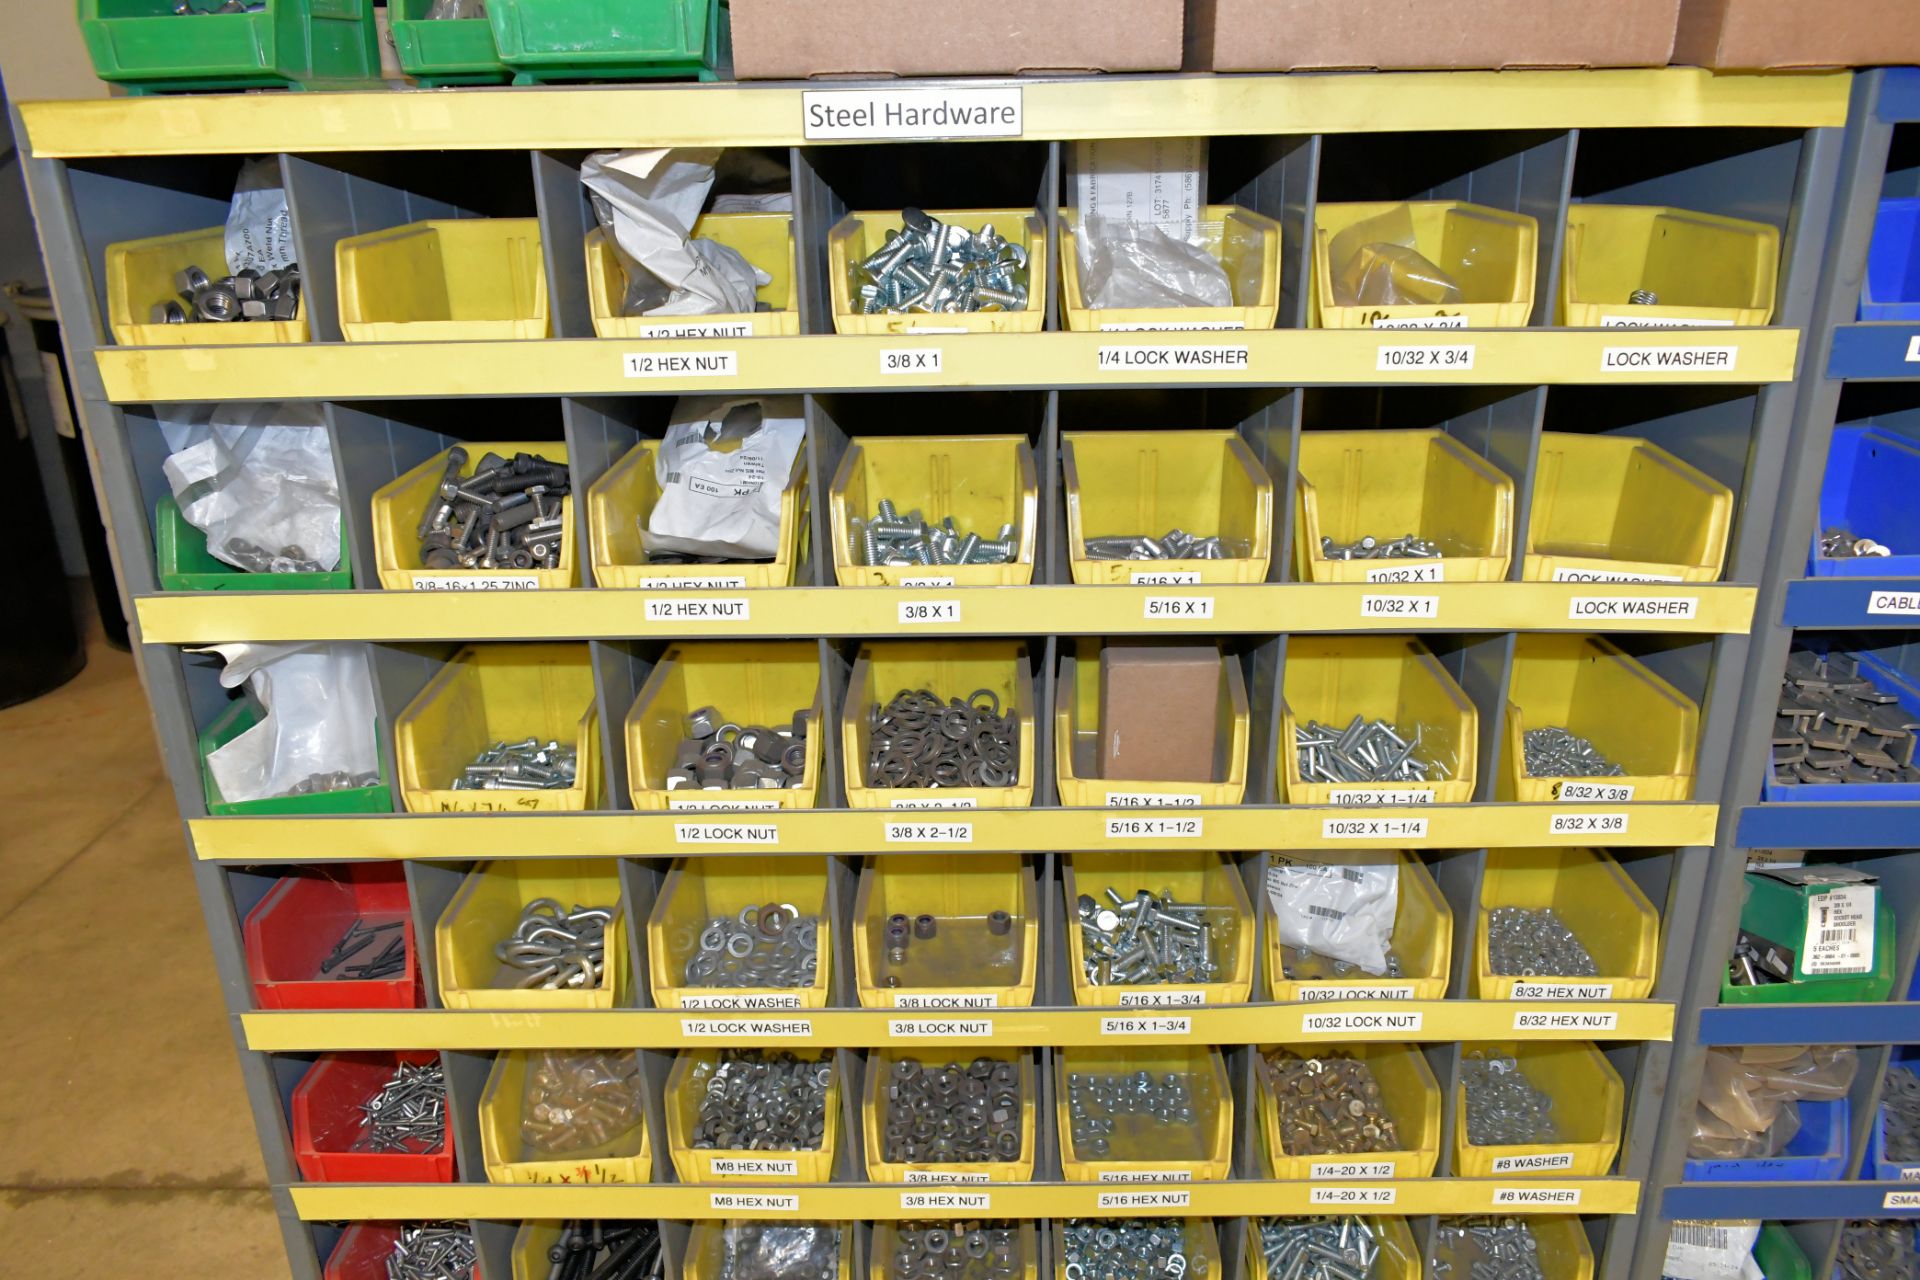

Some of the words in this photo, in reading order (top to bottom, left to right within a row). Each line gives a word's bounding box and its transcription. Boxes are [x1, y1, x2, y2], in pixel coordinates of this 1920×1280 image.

[810, 101, 875, 127] Steel
[885, 100, 1015, 126] Hardware
[887, 354, 910, 369] 3/8
[915, 354, 926, 368] X
[931, 353, 938, 367] 1
[1098, 351, 1120, 364] 1/4
[1125, 351, 1169, 364] LOCK
[1174, 350, 1248, 364] WASHER
[1384, 351, 1424, 365] 10/32
[1429, 351, 1440, 364] X
[1445, 350, 1468, 364] 3/4
[1607, 352, 1651, 366] LOCK
[1657, 352, 1728, 366] WASHER
[631, 358, 653, 372] 1/2
[658, 357, 690, 370] HEX
[696, 356, 728, 370] NUT
[1371, 570, 1409, 583] 10/32
[1414, 569, 1424, 581] X
[1429, 568, 1435, 580] 1
[1149, 601, 1181, 614] 5/16
[1185, 601, 1195, 613] X
[1200, 602, 1206, 613] 1
[1366, 599, 1404, 612] 10/32
[1408, 600, 1419, 613] X
[1425, 601, 1430, 613] 1
[1576, 602, 1617, 614] LOCK
[1622, 602, 1689, 614] WASHER
[1876, 596, 1920, 610] CABL
[652, 604, 672, 615] 1/2
[677, 603, 708, 615] HEX
[713, 603, 744, 615] NUT
[905, 605, 928, 618] 3/8
[932, 605, 942, 617] X
[947, 605, 953, 617] 1
[1564, 786, 1593, 798] 8/32
[1595, 787, 1606, 799] X
[1608, 788, 1628, 800] 3/8
[1110, 797, 1139, 807] 5/16
[1143, 798, 1152, 806] X
[1336, 794, 1371, 804] 10/32
[1376, 794, 1385, 804] X
[1391, 794, 1427, 804] 1-1/4
[1111, 822, 1140, 833] 5/16
[1144, 822, 1153, 833] X
[1159, 821, 1196, 833] 1-1/2
[1329, 823, 1365, 834] 10/32
[1369, 823, 1379, 834] X
[1384, 823, 1421, 834] 1-1/4
[1554, 818, 1584, 829] 8/32
[1588, 818, 1597, 829] X
[1601, 817, 1623, 829] 3/8
[680, 828, 700, 839] 1/2
[704, 828, 743, 839] LOCK
[748, 828, 777, 840] NUT
[892, 827, 912, 838] 3/8
[917, 827, 926, 838] X
[930, 827, 967, 838] 2-1/2
[1278, 856, 1292, 867] PK
[1301, 991, 1335, 1000] 10/32
[1340, 990, 1376, 999] LOCK
[1380, 990, 1408, 999] NUT
[1515, 986, 1543, 997] 8/32
[1547, 987, 1574, 998] HEX
[1578, 987, 1607, 998] NUT
[682, 999, 700, 1008] 1/2
[704, 998, 740, 1008] LOCK
[744, 998, 801, 1008] WASHER
[900, 998, 919, 1008] 3/8
[923, 998, 960, 1008] LOCK
[964, 998, 993, 1008] NUT
[1121, 995, 1149, 1005] 5/16
[1153, 995, 1161, 1005] X
[1167, 995, 1201, 1005] 1-3/4
[1106, 1021, 1134, 1031] 5/16
[1138, 1021, 1147, 1031] X
[1152, 1021, 1186, 1031] 1-3/4
[1308, 1017, 1341, 1028] 10/32
[1345, 1016, 1382, 1027] LOCK
[1387, 1016, 1416, 1027] NUT
[1520, 1015, 1547, 1026] 8/32
[1551, 1015, 1579, 1026] HEX
[1582, 1016, 1612, 1026] NUT
[688, 1023, 706, 1033] 1/2
[710, 1023, 747, 1033] LOCK
[751, 1023, 810, 1033] WASHER
[895, 1023, 915, 1033] 3/8
[919, 1023, 956, 1033] LOCK
[960, 1023, 988, 1033] NUT
[716, 1162, 734, 1171] M8
[738, 1162, 763, 1172] HEX
[767, 1163, 793, 1172] NUT
[1497, 1160, 1511, 1169] #8
[1514, 1156, 1568, 1168] WASHER
[1317, 1166, 1356, 1175] 1/4-20
[1360, 1166, 1368, 1175] X
[1373, 1165, 1390, 1175] 1/2
[909, 1174, 927, 1182] 3/8
[1103, 1174, 1128, 1182] 5/16
[906, 1196, 924, 1206] 3/8
[929, 1196, 955, 1206] HEX
[959, 1196, 985, 1206] NUT
[1102, 1196, 1128, 1205] 5/16
[1132, 1195, 1158, 1204] HEX
[1162, 1194, 1188, 1204] NUT
[1316, 1191, 1356, 1200] 1/4-20
[1359, 1191, 1368, 1200] X
[1373, 1191, 1391, 1200] 1/2
[1500, 1192, 1514, 1201] #8
[1518, 1192, 1575, 1201] WASHER
[715, 1197, 733, 1206] M8
[737, 1197, 763, 1207] HEX
[767, 1198, 793, 1207] NUT
